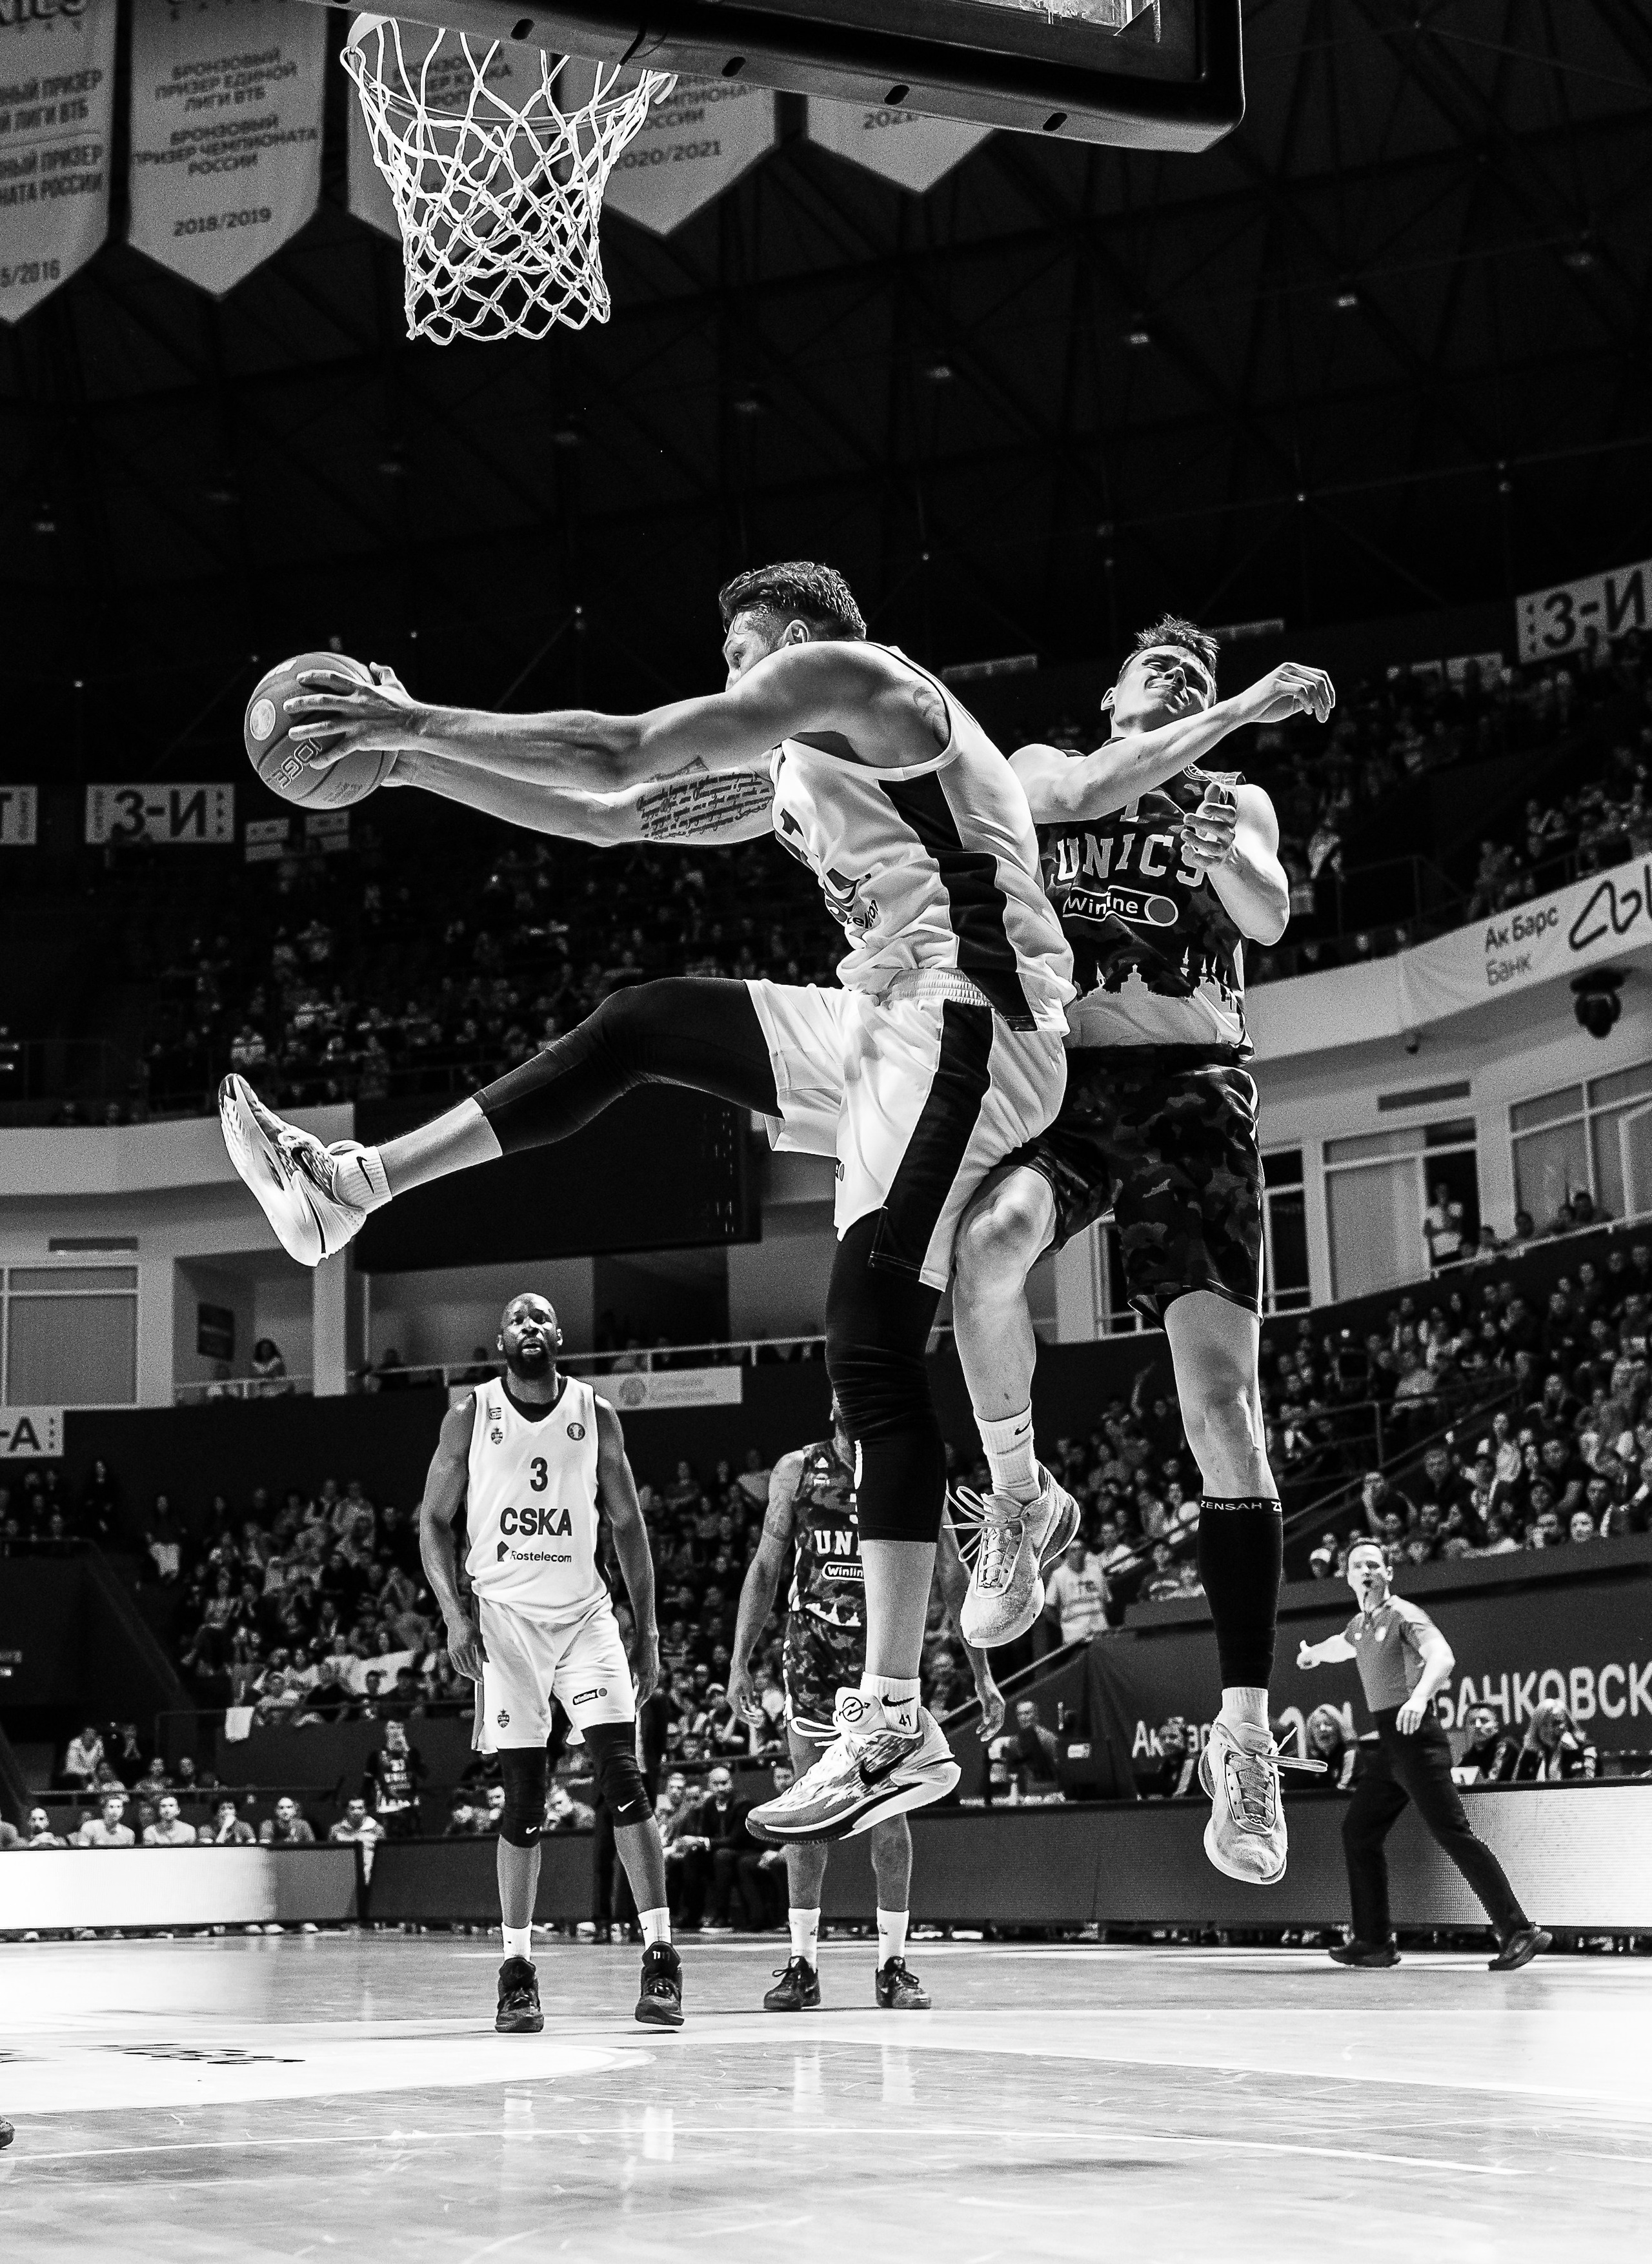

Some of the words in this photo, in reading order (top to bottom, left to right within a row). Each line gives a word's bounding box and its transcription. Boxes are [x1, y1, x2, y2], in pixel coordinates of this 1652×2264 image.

[640, 108, 705, 132] ОССИИ
[173, 206, 272, 238] 2018/2019
[1068, 893, 1138, 915] Winine
[1485, 927, 1510, 954] Ак
[1512, 905, 1558, 942] Барс
[1486, 953, 1533, 986] Банк
[530, 1457, 548, 1492] 3
[1201, 1500, 1262, 1511] ZENSAH
[499, 1507, 572, 1537] CSKA
[510, 1550, 572, 1563] Rostelecom
[899, 1714, 912, 1728] 41
